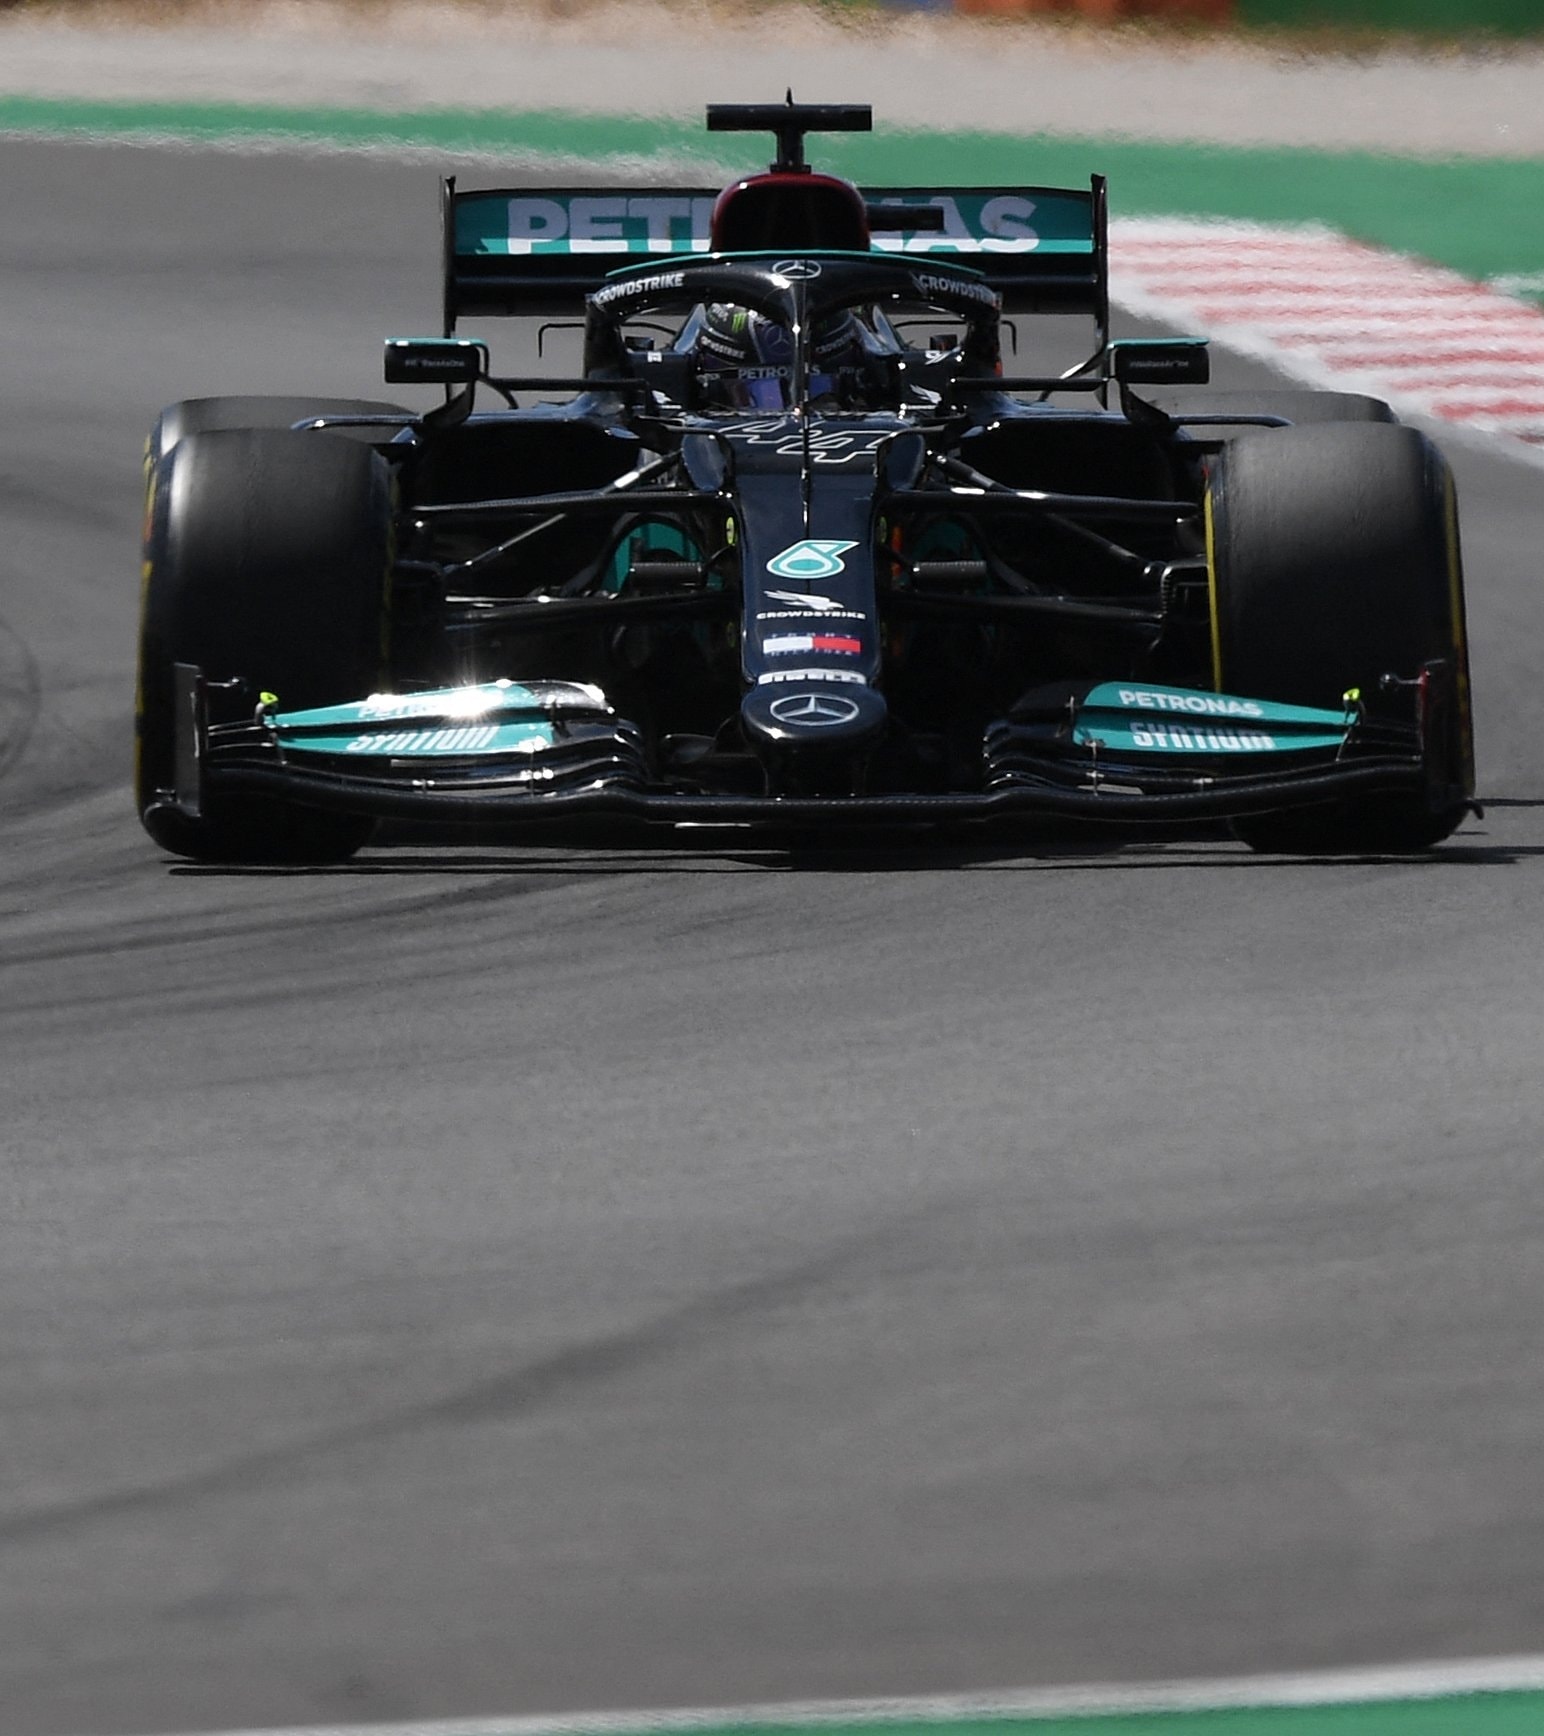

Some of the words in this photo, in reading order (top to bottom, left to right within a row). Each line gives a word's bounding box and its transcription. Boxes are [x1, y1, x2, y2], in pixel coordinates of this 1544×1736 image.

[508, 197, 1040, 255] PETAS
[737, 364, 822, 379] PETROS
[756, 611, 866, 619] CROWDSTRIKE
[1119, 689, 1264, 716] PETRONAS
